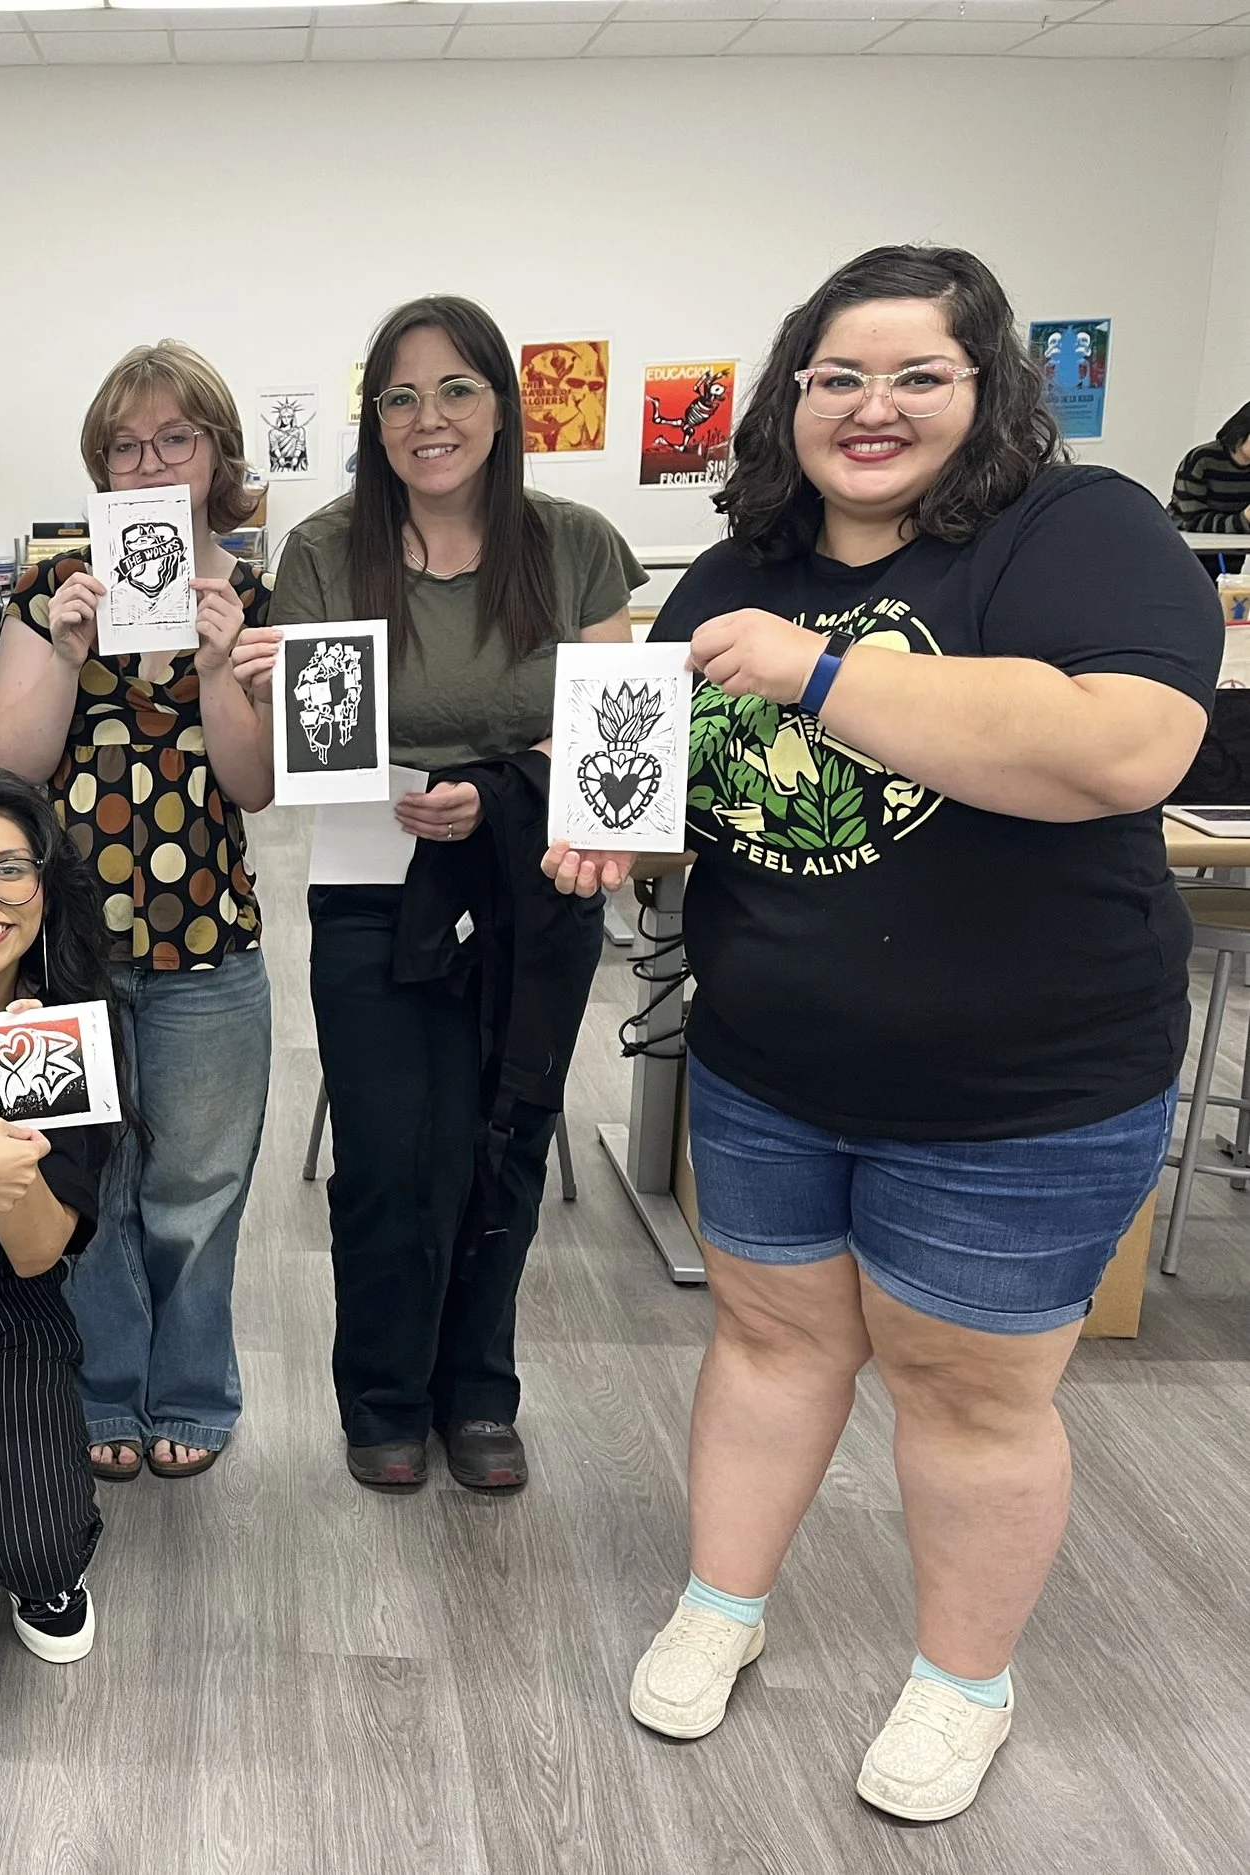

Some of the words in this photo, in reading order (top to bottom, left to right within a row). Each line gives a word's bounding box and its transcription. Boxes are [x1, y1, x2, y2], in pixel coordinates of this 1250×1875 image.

[706, 460, 727, 473] SIN
[121, 553, 144, 572] THE
[144, 536, 182, 561] WOLVES
[814, 602, 867, 627] MAK
[732, 838, 794, 875] FEEL
[802, 842, 881, 876] ALIVE
